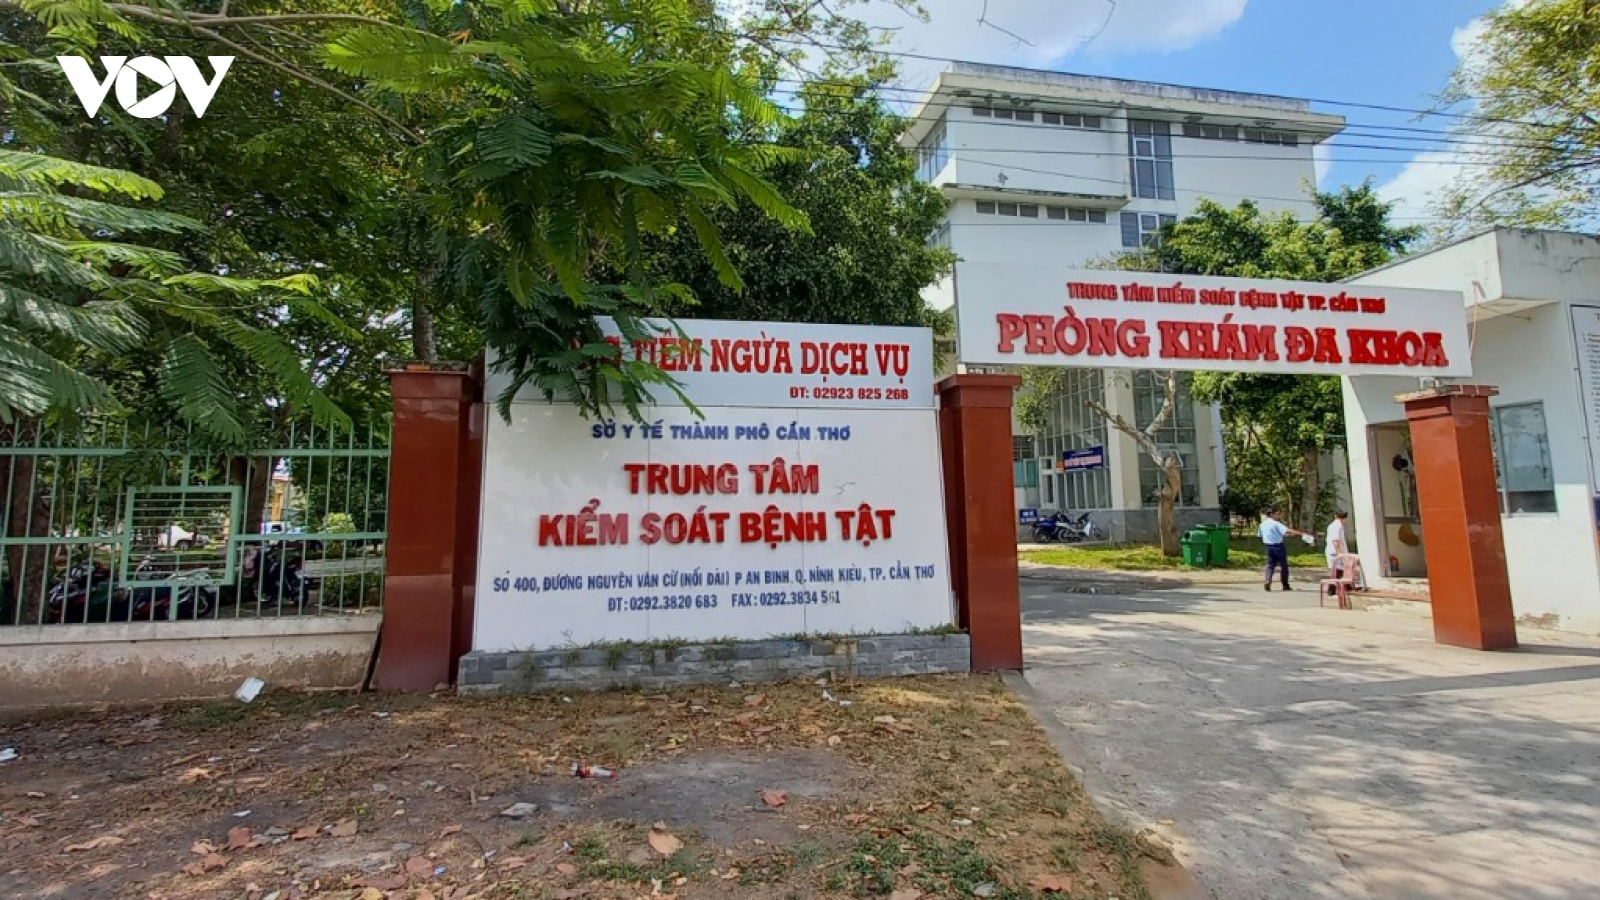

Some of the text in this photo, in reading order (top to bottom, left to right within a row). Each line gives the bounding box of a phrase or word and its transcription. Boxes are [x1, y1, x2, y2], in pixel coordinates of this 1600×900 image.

[1067, 282, 1118, 300] TRUNG
[1121, 283, 1154, 302] TÂM
[1199, 287, 1236, 306] SOÁT
[1239, 289, 1278, 310] BỆNH
[1308, 295, 1328, 310] TP.
[996, 305, 1449, 367] PHÒNG KHÁM ĐA KHOA
[710, 331, 793, 374] NGỪA
[800, 342, 869, 382] DỊCH
[875, 344, 910, 384] VỤ
[790, 387, 909, 400] ĐT: 02923 825 268
[592, 418, 616, 439] SỞ
[622, 425, 634, 439] Y
[641, 419, 664, 439] TẾ
[670, 421, 729, 440] THÀNH
[818, 426, 851, 441] THƠ
[624, 456, 819, 495] TRUNG TÂM
[538, 498, 896, 550] KIỂM SOÁT BỆNH TẬT
[513, 577, 540, 593] 400,
[746, 571, 761, 585] AN
[870, 567, 886, 580] TP.
[915, 563, 935, 579] THƠ
[695, 594, 718, 608] 683
